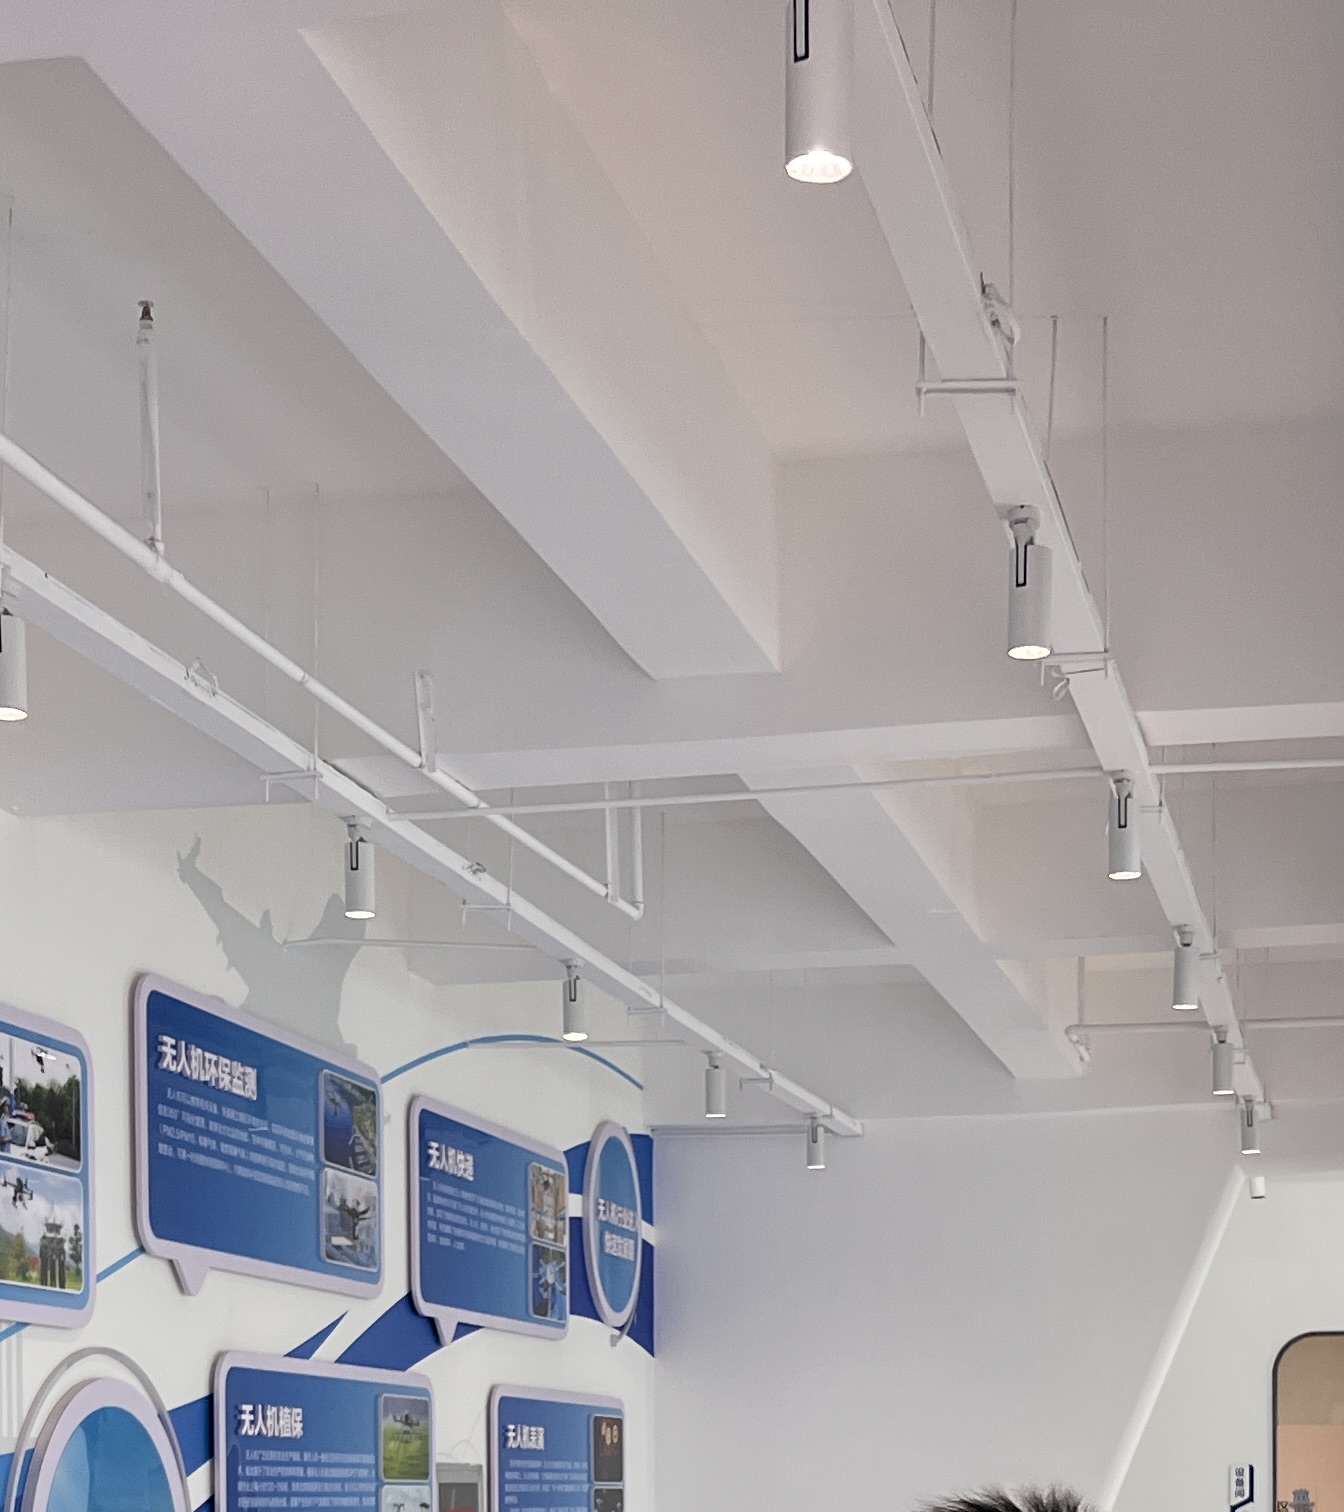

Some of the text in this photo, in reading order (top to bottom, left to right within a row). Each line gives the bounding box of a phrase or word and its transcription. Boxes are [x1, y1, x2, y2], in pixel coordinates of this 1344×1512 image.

[239, 1404, 304, 1439] 无人机植保
